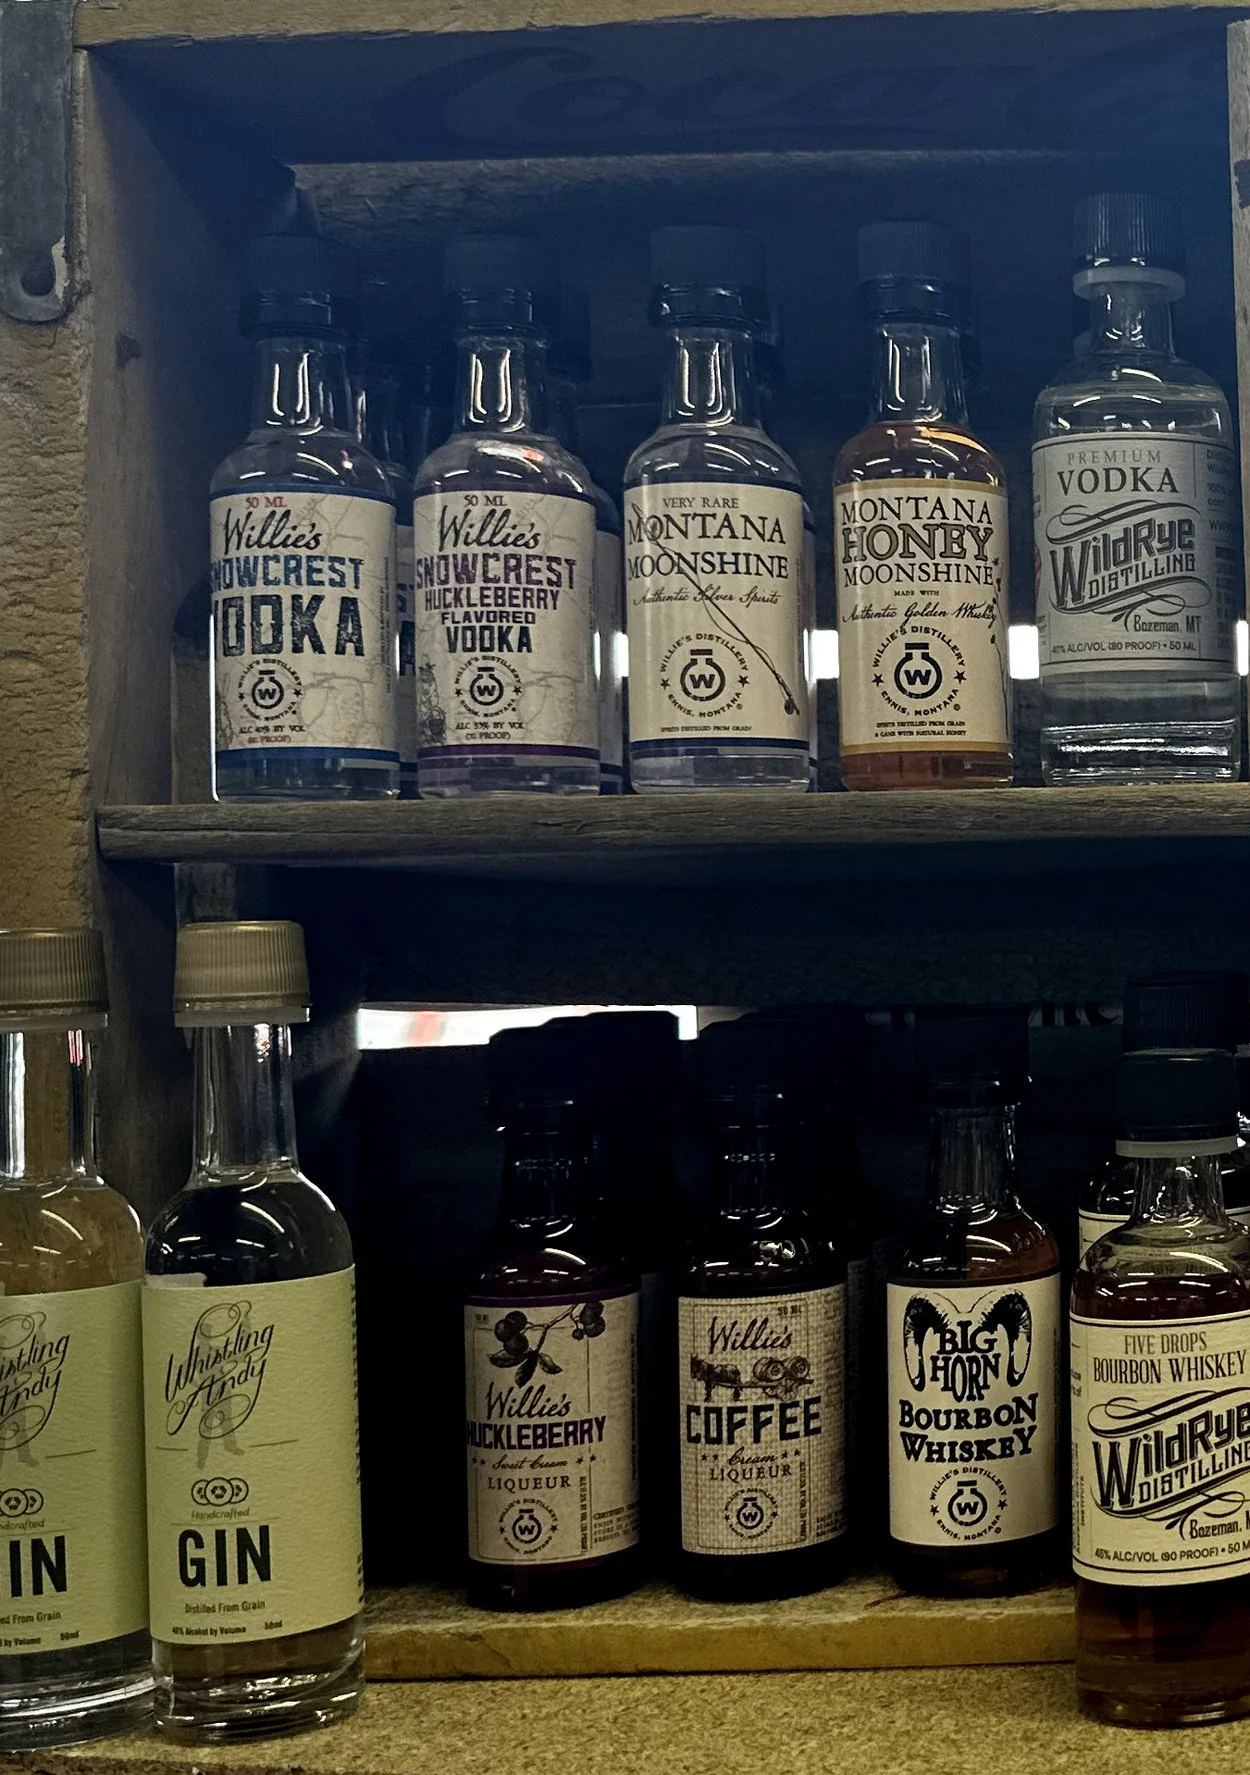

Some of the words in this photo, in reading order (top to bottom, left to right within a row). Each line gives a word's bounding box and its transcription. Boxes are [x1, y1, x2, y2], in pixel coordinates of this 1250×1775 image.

[1067, 450, 1162, 465] PREMIUM
[1057, 467, 1179, 495] VODKA
[245, 497, 259, 509] 50
[265, 496, 287, 508] ML
[464, 496, 479, 507] 50
[485, 495, 507, 506] ML
[663, 498, 696, 508] VERY
[702, 498, 739, 508] RARE
[841, 496, 992, 525] MONTANA
[224, 508, 322, 555] Willie's
[438, 505, 541, 552] Willie's
[628, 512, 786, 545] MONTANA
[843, 523, 993, 563] HONEY
[416, 553, 577, 589] SNOWCREST
[628, 552, 788, 580] MOONSHINE
[843, 562, 993, 588] MOONSHINE
[1050, 518, 1195, 608] WildRye
[1088, 554, 1196, 600] DISTILLING
[425, 587, 560, 611] HUCKLEBERRY
[633, 587, 689, 606] Authentic
[739, 585, 782, 608] Spirits
[214, 594, 365, 657] ODKA
[441, 611, 536, 624] FLAVORED
[843, 603, 898, 622] Authentic
[903, 602, 948, 627] Golden
[951, 601, 997, 629] Whiskey
[1186, 615, 1202, 633] MT
[446, 625, 533, 653] VODKA
[660, 635, 692, 673] WILLIE'S
[695, 633, 749, 671] DISTILLERY
[872, 628, 907, 667] WILLIE'S
[911, 626, 965, 666] DISTILLERY
[1067, 642, 1106, 652] ALC/VOL
[1124, 641, 1161, 650] PROOF)
[477, 685, 496, 696] W
[690, 674, 715, 689] W
[905, 670, 931, 685] W
[914, 688, 959, 716] MONTANA
[709, 1316, 793, 1355] Willie's
[937, 1320, 997, 1354] BIG
[1124, 1334, 1158, 1355] FIVE
[1161, 1331, 1207, 1352] DROPS
[165, 1300, 275, 1402] Whistling
[929, 1353, 1000, 1401] HORN
[1093, 1359, 1161, 1385] BOURBON
[1168, 1350, 1246, 1382] WHISKEY
[166, 1352, 267, 1439] Andy
[486, 1381, 572, 1420] Willie's
[686, 1396, 822, 1445] COFFEE
[899, 1393, 1038, 1431] BOURBON
[466, 1416, 606, 1450] HUCKLEBERRY
[900, 1425, 1037, 1463] WHISKEY
[492, 1454, 525, 1470] Sweet
[530, 1454, 568, 1469] Cream
[727, 1446, 778, 1466] Cream
[488, 1475, 571, 1494] LIQUEUR
[710, 1464, 792, 1483] LIQUEUR
[930, 1470, 959, 1500] WILLIE'S
[963, 1467, 1007, 1496] DISTILLERY
[191, 1507, 250, 1520] Handcrafted
[957, 1502, 979, 1515] W
[518, 1525, 535, 1535] W
[9, 1535, 67, 1598] IN
[178, 1525, 271, 1587] GIN
[1113, 1552, 1158, 1562] ALC/VOL
[1180, 1548, 1218, 1559] PROOF)
[1228, 1543, 1240, 1553] 50
[37, 1611, 61, 1622] Grain
[218, 1603, 239, 1613] From
[241, 1600, 265, 1611] Grain
[219, 1626, 246, 1634] Volume
